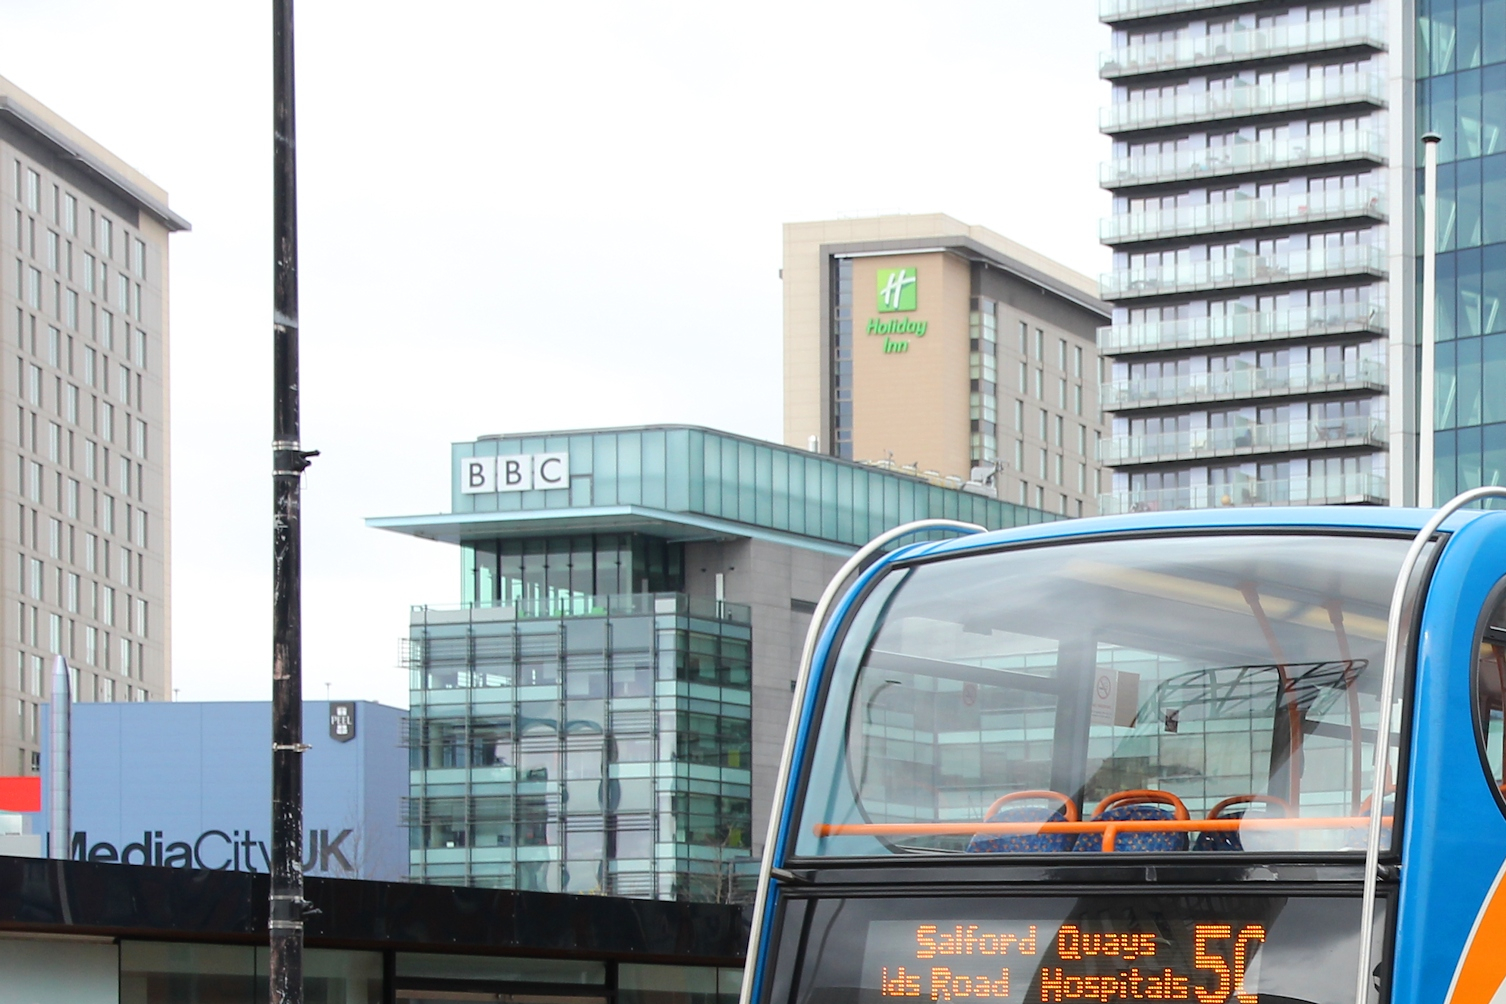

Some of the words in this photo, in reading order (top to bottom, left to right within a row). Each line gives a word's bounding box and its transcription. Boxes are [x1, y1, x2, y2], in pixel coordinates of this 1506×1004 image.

[866, 317, 928, 337] Holiday
[884, 336, 909, 353] Inn
[469, 457, 561, 488] BBC
[331, 715, 352, 725] PEEL
[916, 925, 1036, 959] Salford
[1057, 924, 1156, 960] Quays
[931, 966, 1009, 1001] Road
[1040, 967, 1188, 1003] Hospitals
